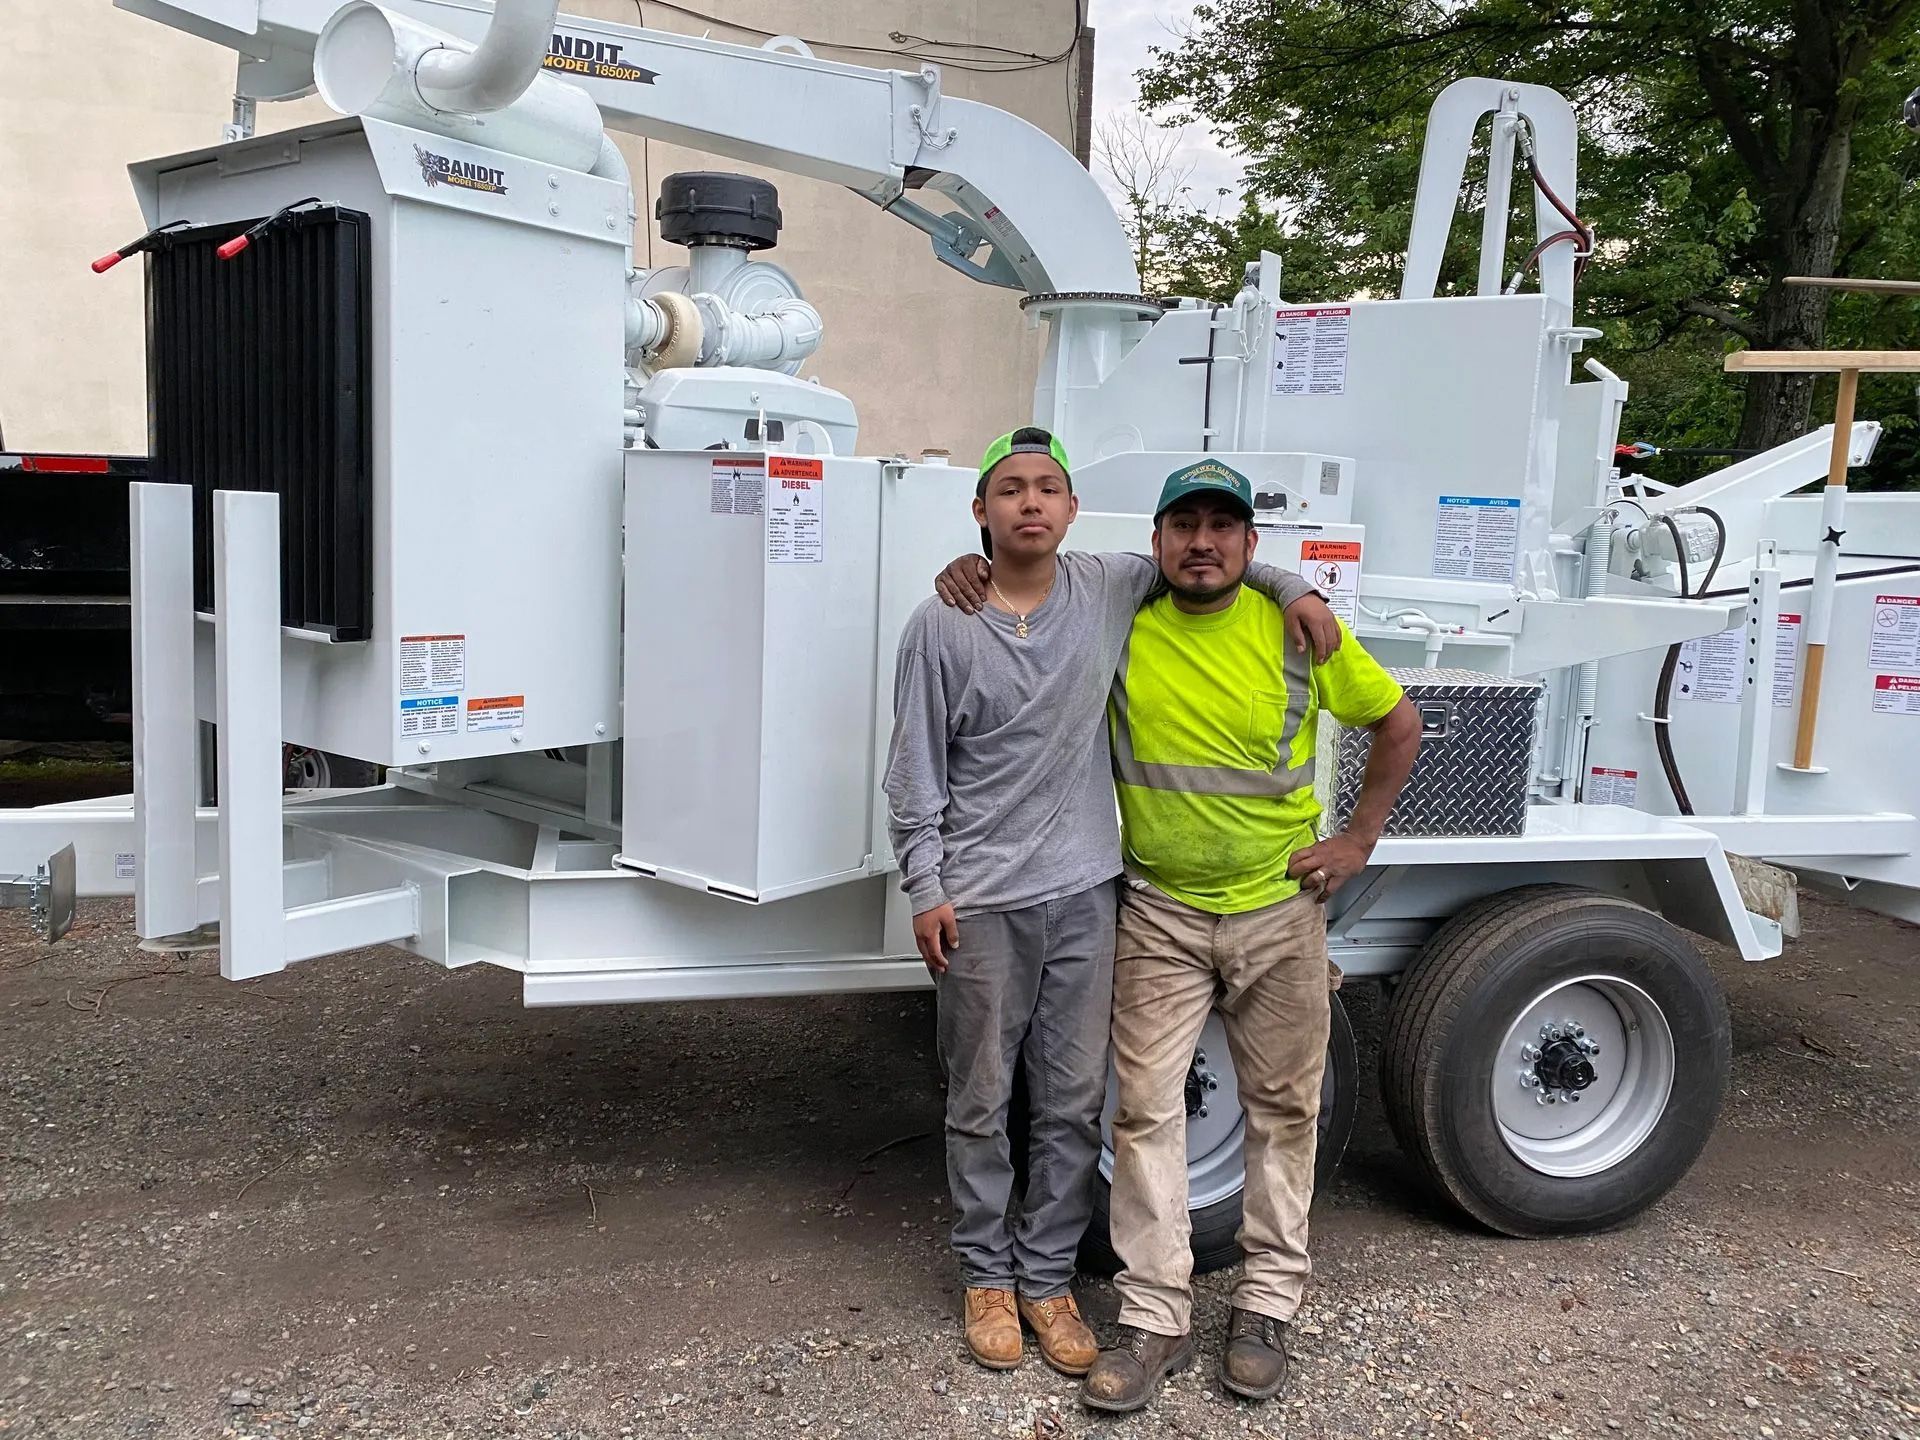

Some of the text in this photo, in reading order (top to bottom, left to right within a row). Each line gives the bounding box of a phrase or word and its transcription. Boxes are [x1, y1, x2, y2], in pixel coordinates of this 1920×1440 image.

[548, 34, 623, 65] NDIT
[544, 56, 641, 80] MODEL 1850XP
[438, 156, 505, 186] BANDIT
[447, 175, 472, 187] MODEL
[781, 480, 811, 490] DIESEL
